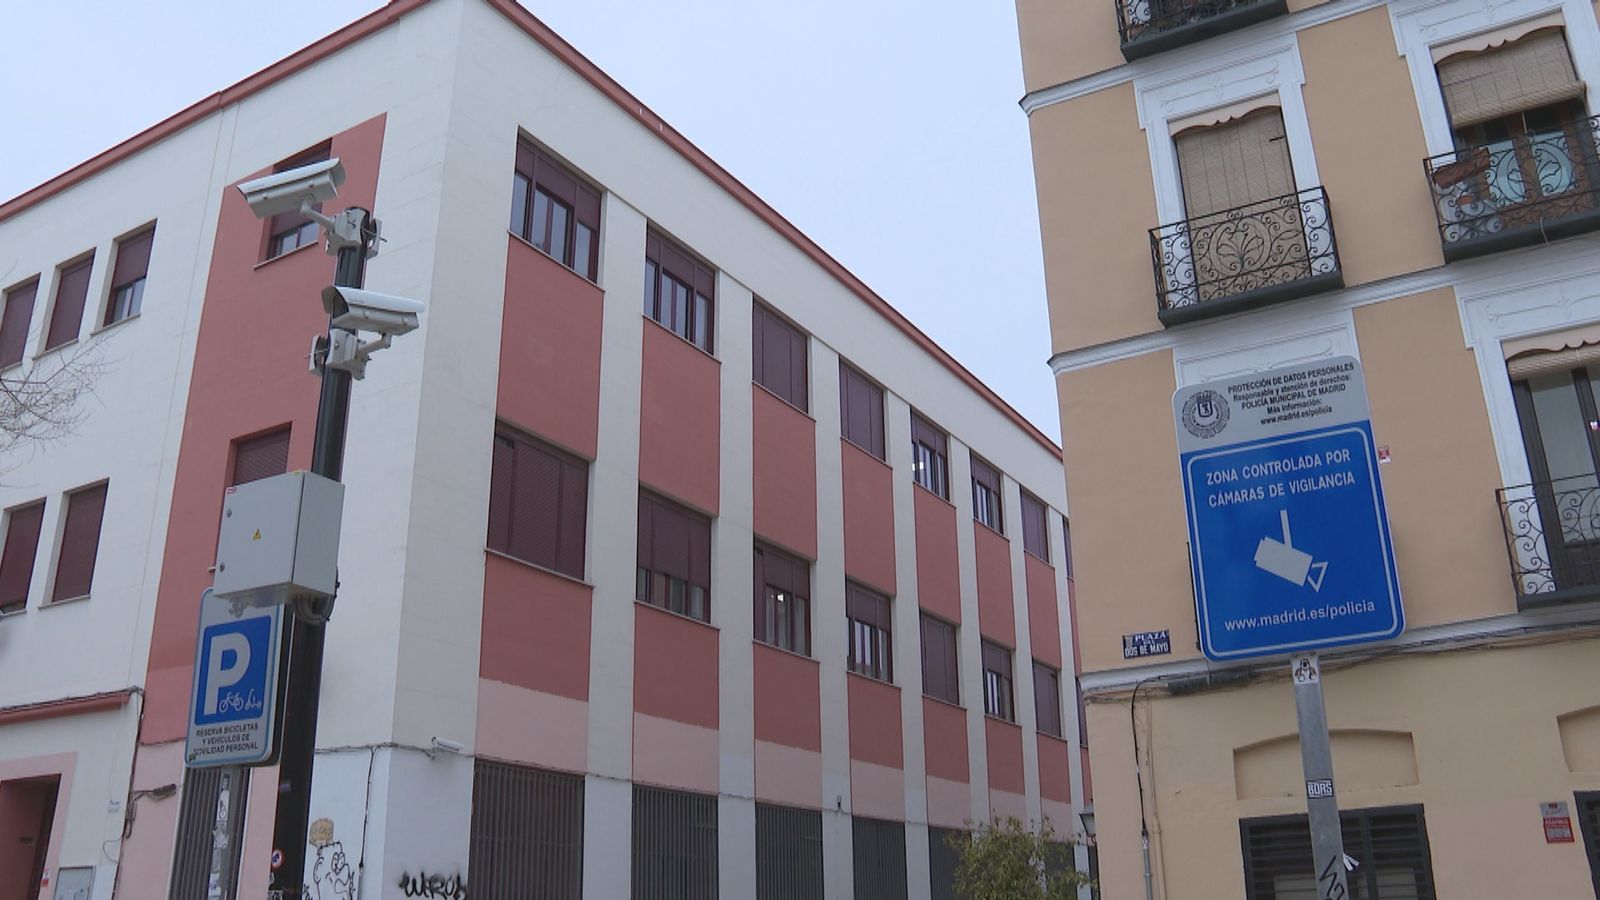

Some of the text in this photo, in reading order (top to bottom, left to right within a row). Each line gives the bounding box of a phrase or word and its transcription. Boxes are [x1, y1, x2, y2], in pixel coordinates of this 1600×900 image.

[1228, 361, 1354, 394] PROTECCIÓN DE DATOS PERSONALES
[1269, 390, 1307, 404] MUNICIPAL
[1307, 388, 1318, 398] DE
[1318, 383, 1346, 395] MADRID
[1275, 387, 1280, 396] y
[1309, 379, 1318, 388] de
[1267, 404, 1281, 414] Más
[1206, 448, 1351, 486] ZONA CONTROLADA POR
[1208, 471, 1356, 508] CÁMARAS DE VIGILANCIA
[1224, 600, 1375, 631] www.madrid.es/policia
[1135, 631, 1166, 641] PLAZA
[1125, 641, 1169, 657] DOS DE MAYO
[203, 632, 251, 716] P
[196, 722, 259, 737] RESERVA BICICLETAS
[202, 733, 250, 746] Y VEHÍCULOS DE
[225, 741, 258, 752] PERSONAL
